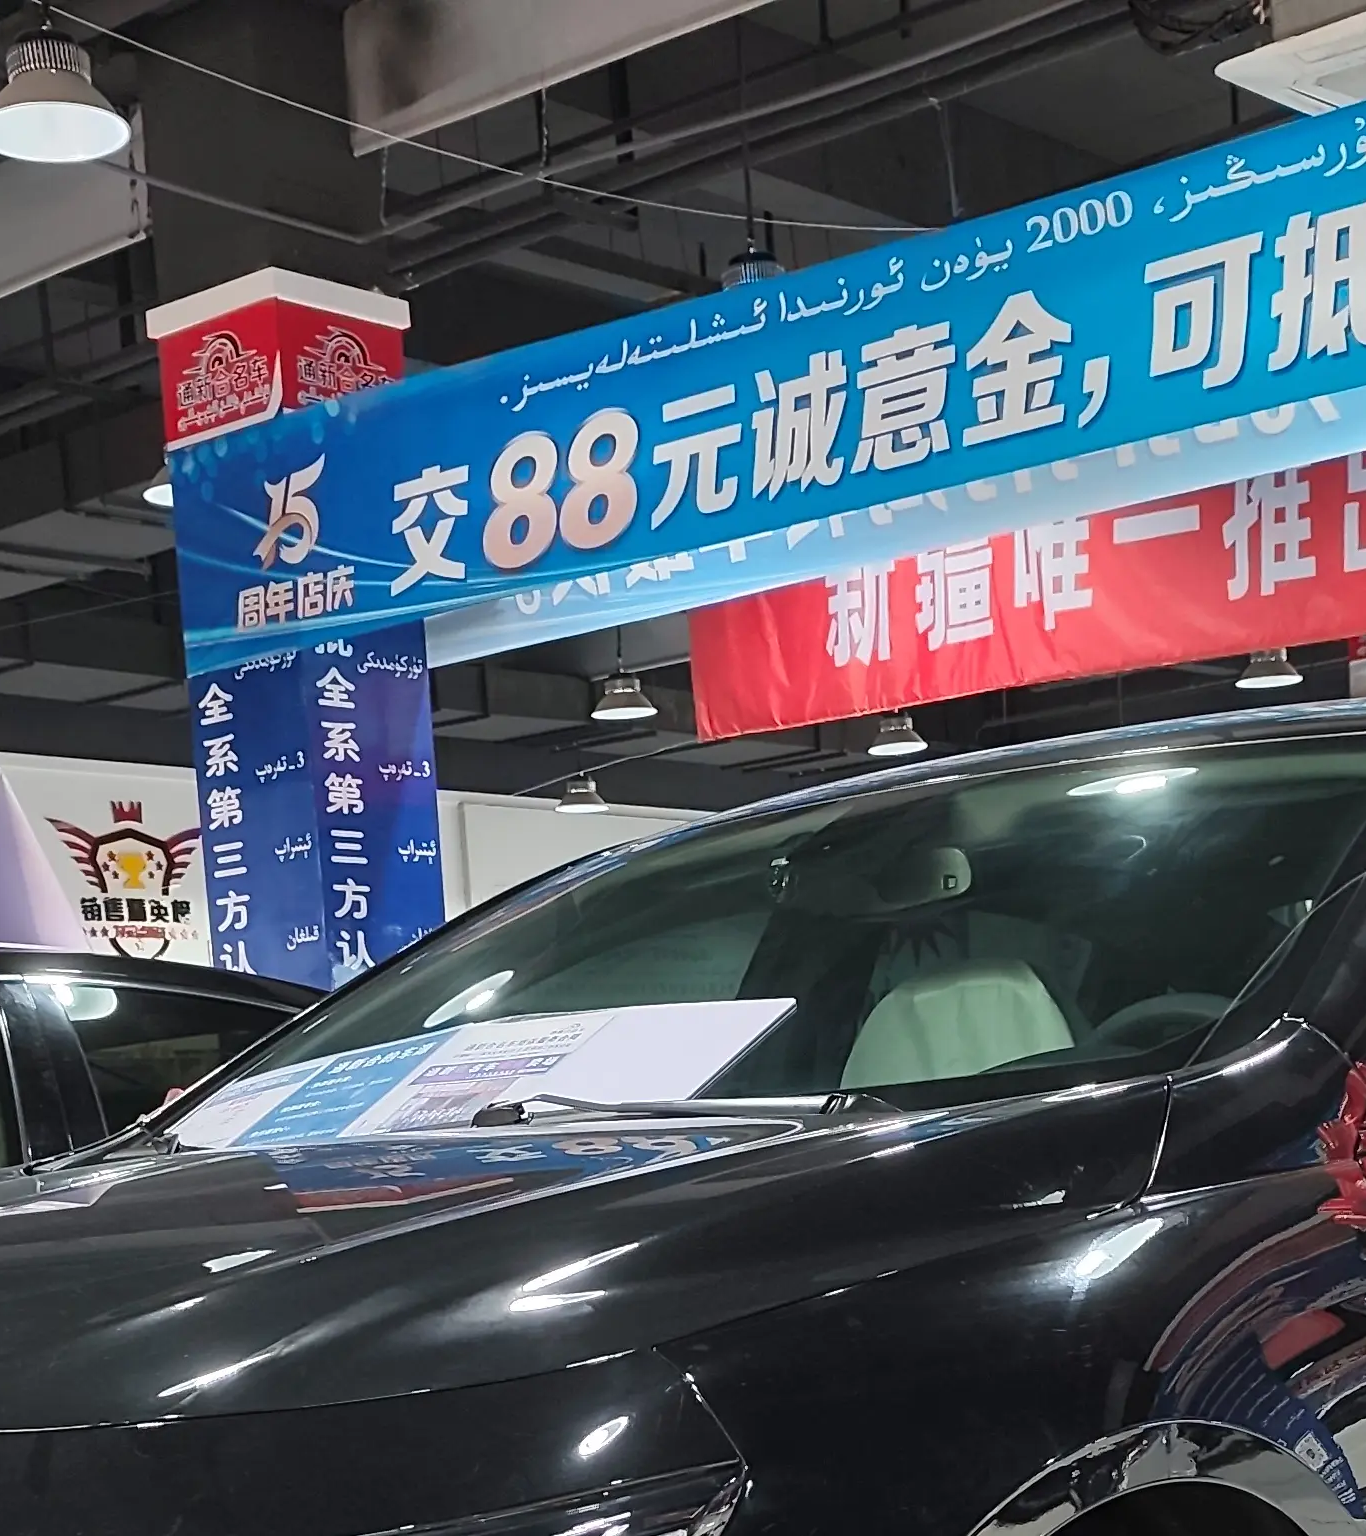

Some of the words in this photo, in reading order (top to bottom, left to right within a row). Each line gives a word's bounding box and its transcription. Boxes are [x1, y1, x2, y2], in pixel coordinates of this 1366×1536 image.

[1025, 189, 1133, 254] 2000
[236, 564, 356, 633] 周年店庆
